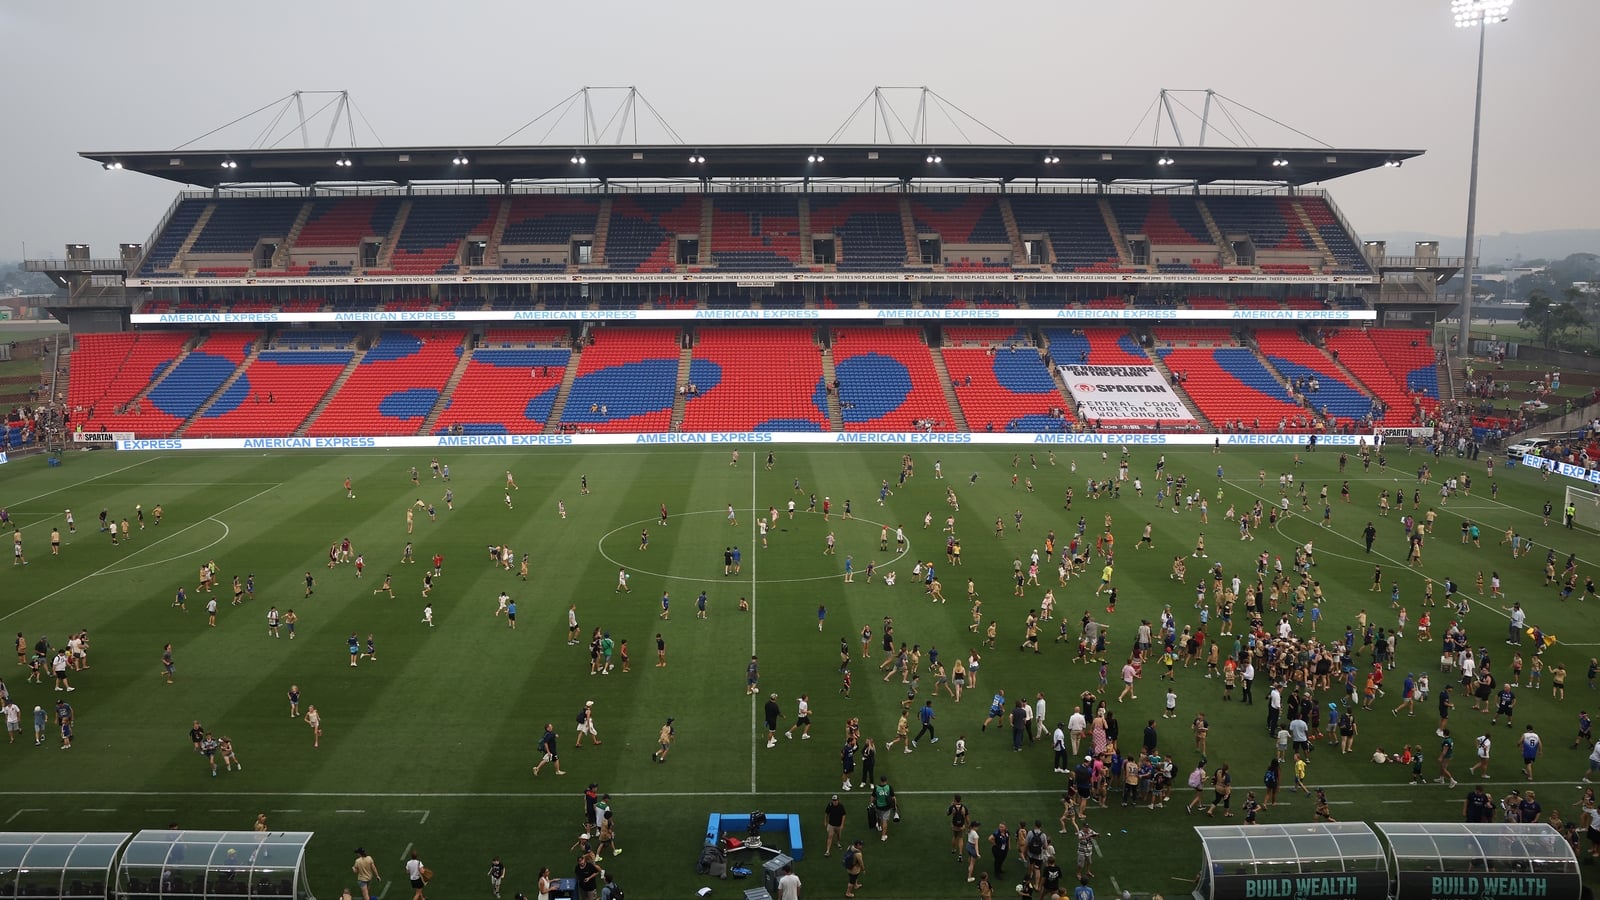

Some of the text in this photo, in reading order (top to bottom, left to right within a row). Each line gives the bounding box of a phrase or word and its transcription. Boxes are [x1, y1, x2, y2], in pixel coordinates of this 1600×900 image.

[1096, 384, 1166, 392] SPARTAN
[438, 435, 572, 445] AMERICAN EXPRESS
[636, 433, 772, 443] AMERICAN EXPRESS
[836, 433, 971, 442] AMERICAN EXPRESS
[1034, 434, 1166, 443] AMERICAN EXPRESS
[1227, 435, 1294, 444] AMERICAN
[124, 440, 182, 449] EXPRESS
[244, 438, 375, 448] AMERICAN EXPRESS
[1246, 877, 1357, 898] BUILD WEALTH
[1432, 876, 1546, 896] BUILD WEALTH
